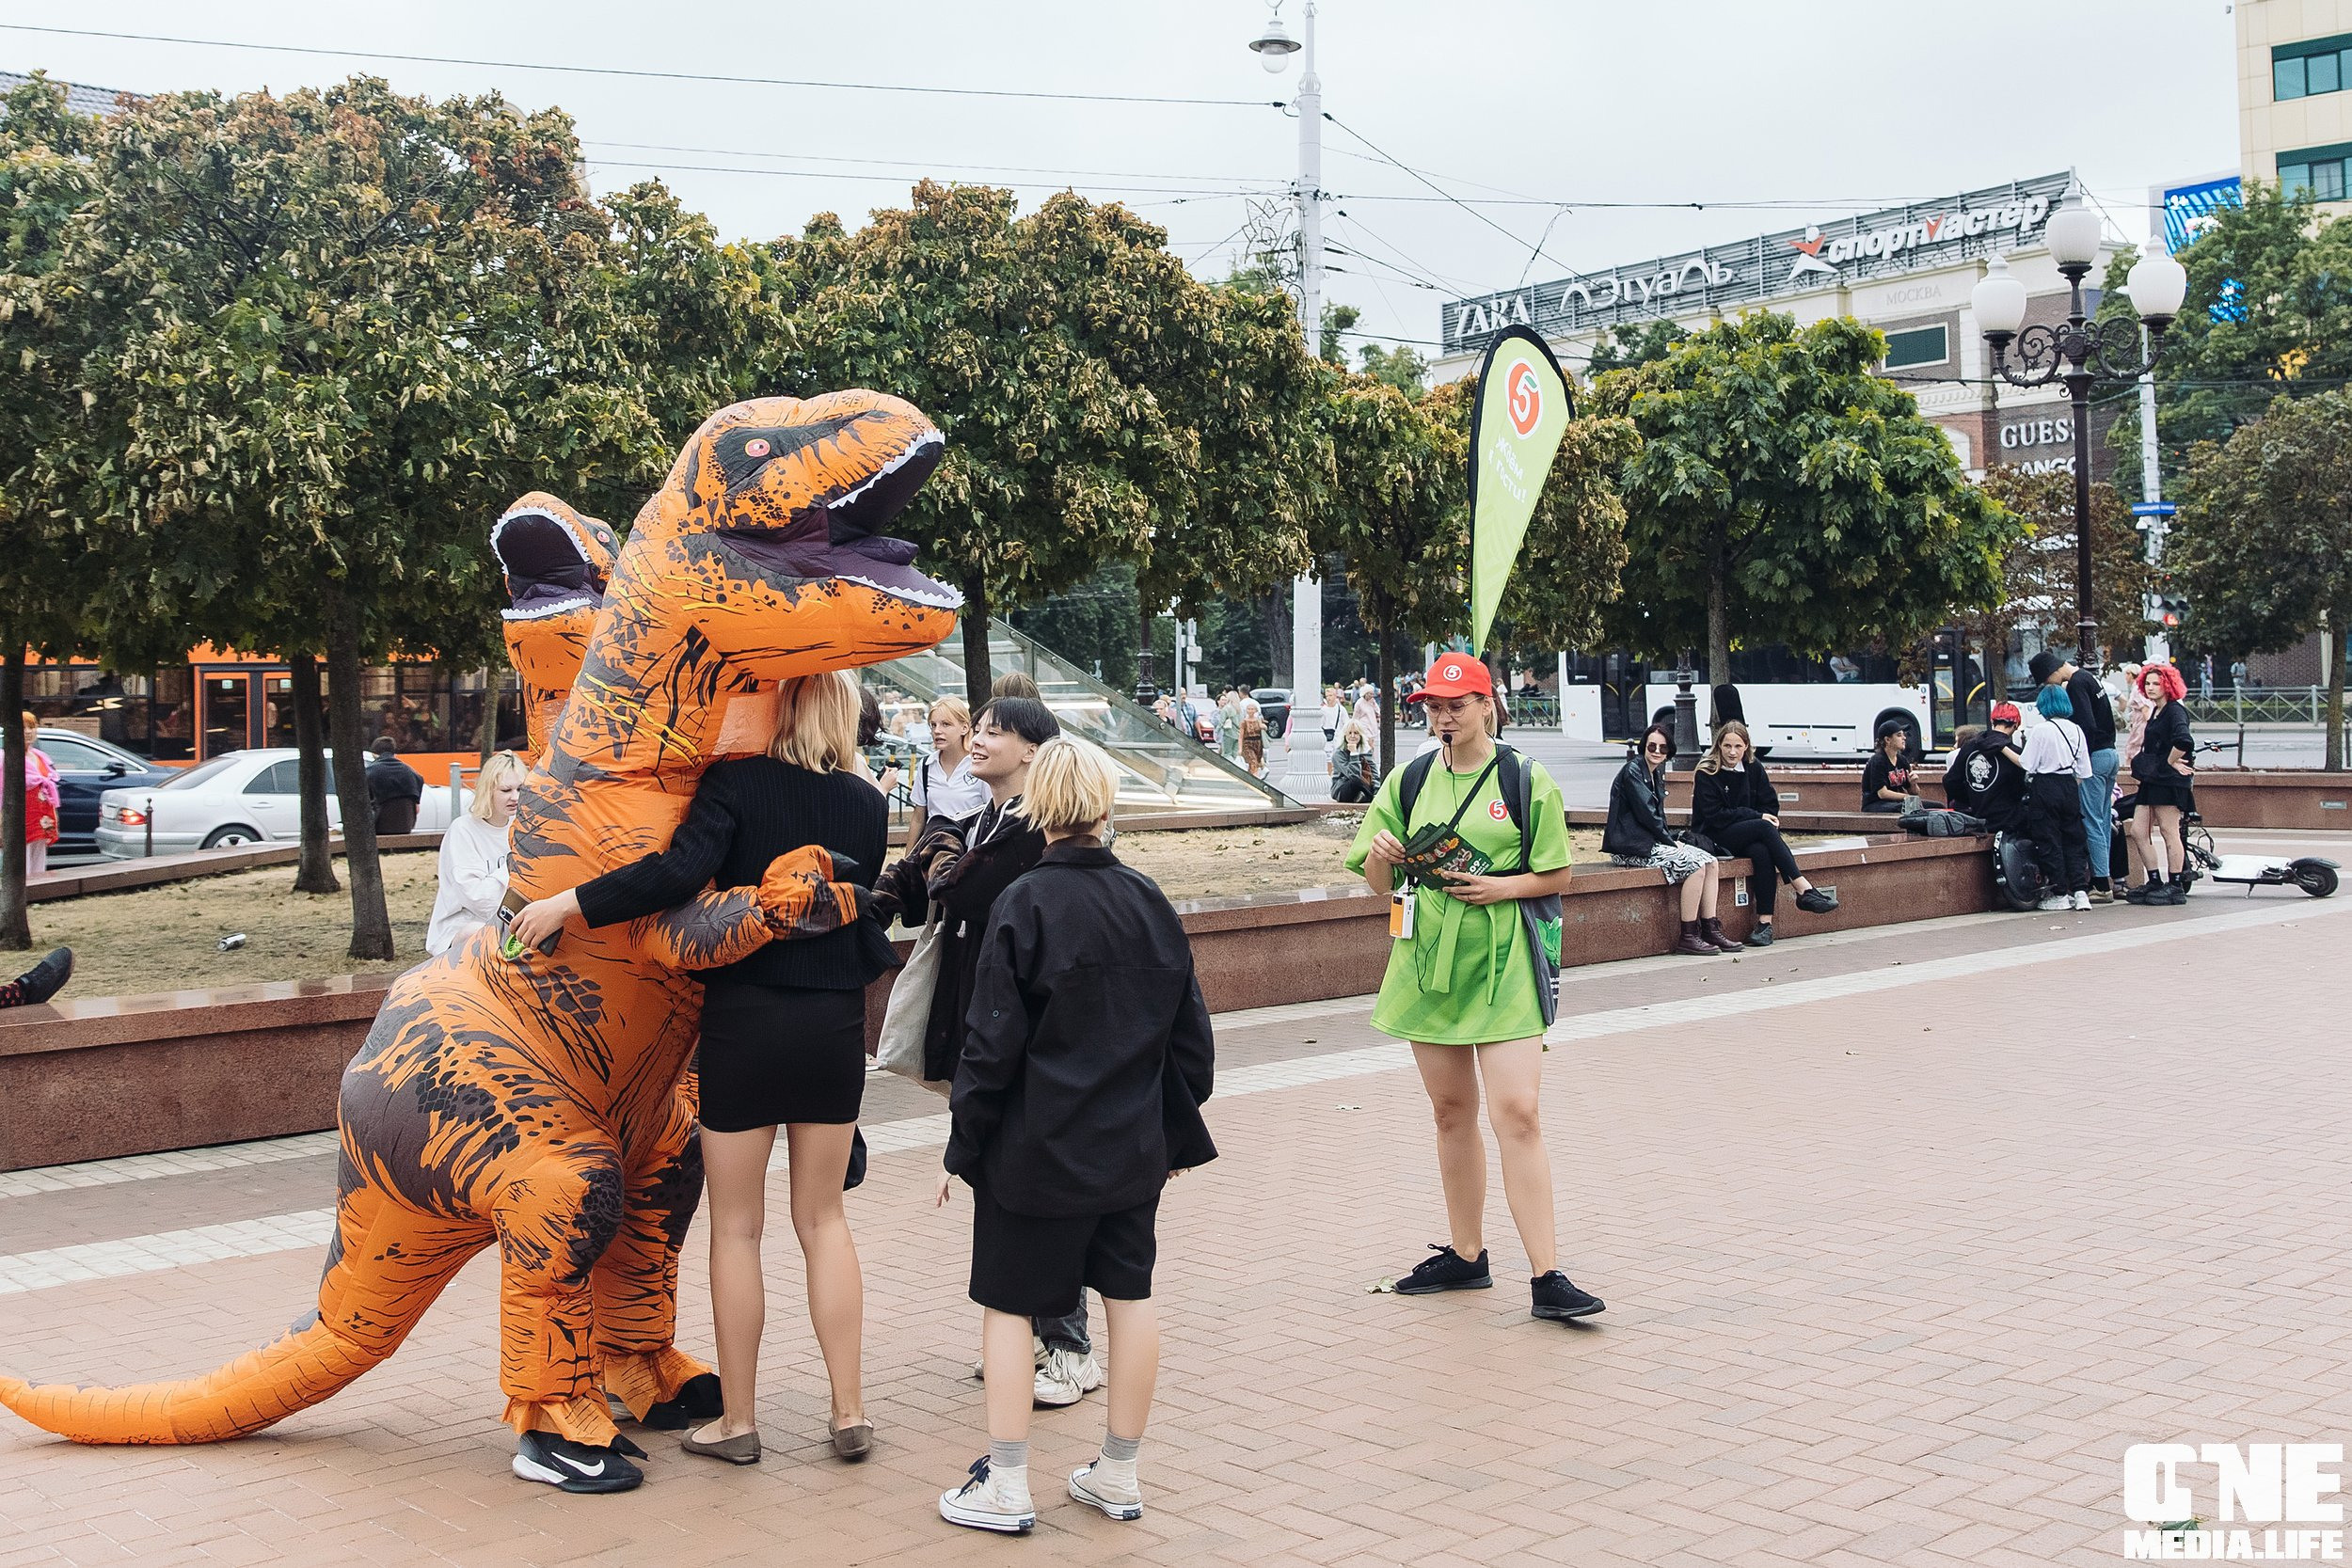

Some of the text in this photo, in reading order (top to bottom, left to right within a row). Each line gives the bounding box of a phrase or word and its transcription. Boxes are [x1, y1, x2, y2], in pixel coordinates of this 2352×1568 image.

[1886, 285, 1942, 306] МОСКВА
[1454, 294, 1532, 338] ZARA
[1999, 418, 2076, 449] GUES
[2010, 456, 2076, 478] ANG
